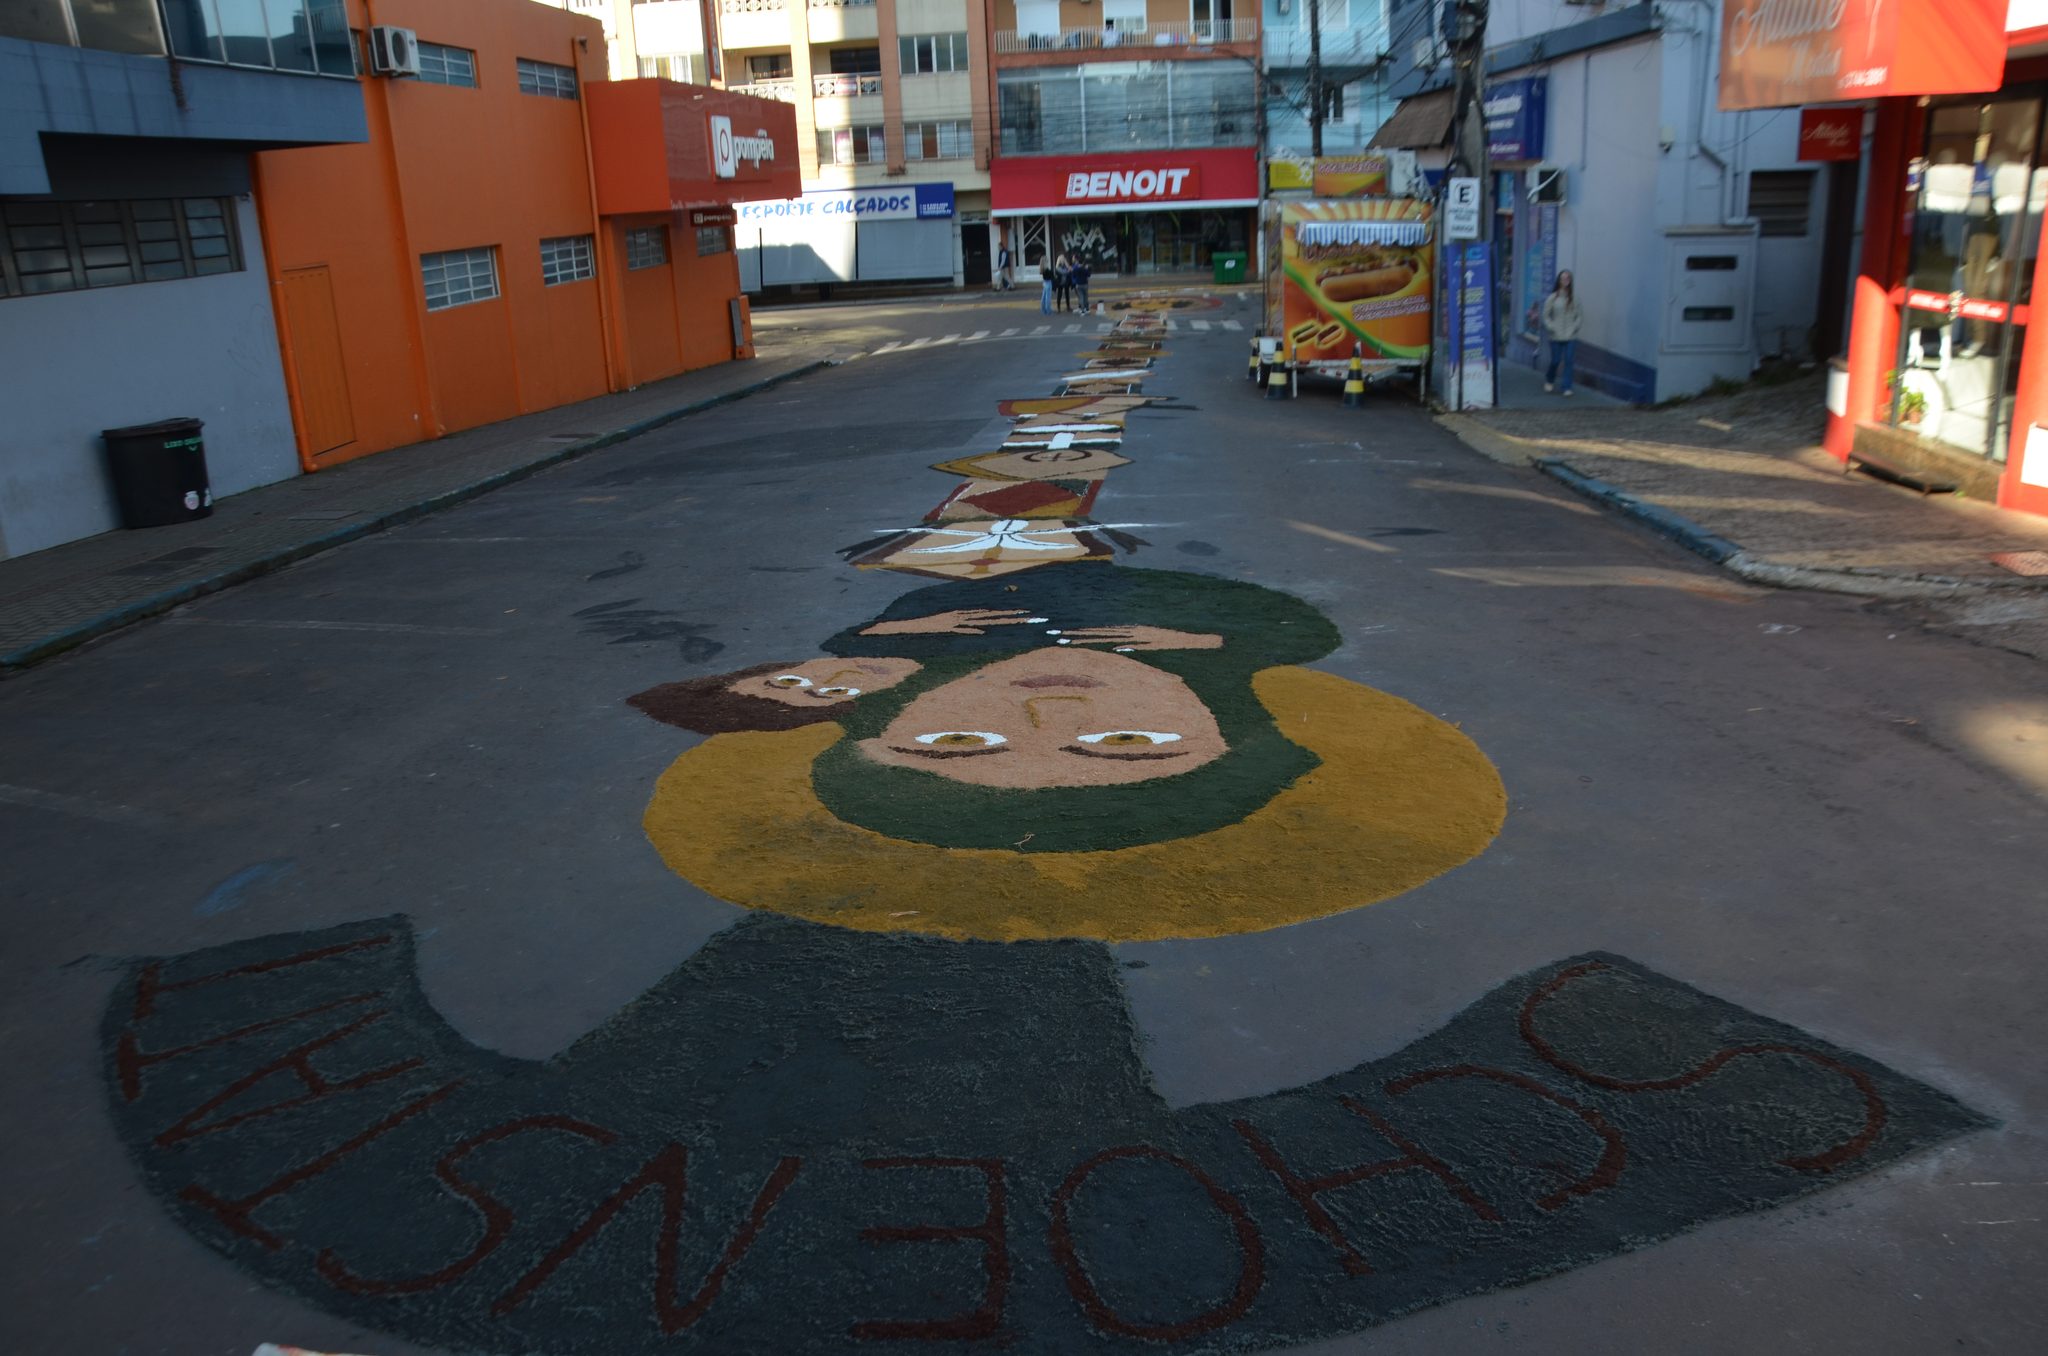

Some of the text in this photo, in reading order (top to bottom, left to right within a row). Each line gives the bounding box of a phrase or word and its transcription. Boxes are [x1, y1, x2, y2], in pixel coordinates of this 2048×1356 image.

[1066, 168, 1190, 199] BENOIT
[1459, 185, 1471, 203] E
[741, 201, 815, 219] ESPORTE
[823, 195, 911, 216] CALÇADOS
